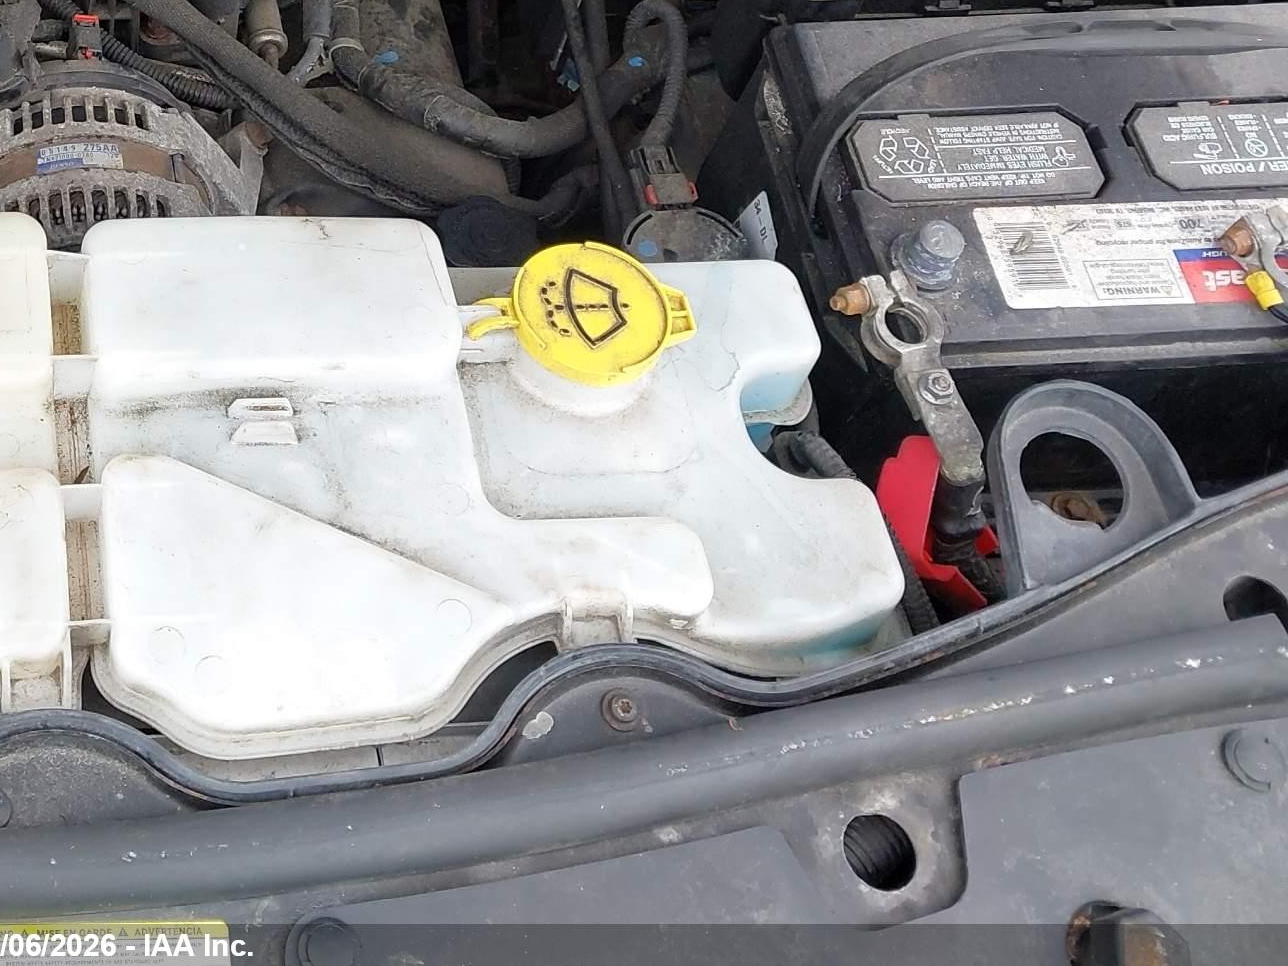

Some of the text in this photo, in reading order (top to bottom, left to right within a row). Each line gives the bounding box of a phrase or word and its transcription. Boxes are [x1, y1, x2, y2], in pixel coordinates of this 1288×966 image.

[992, 147, 1012, 155] HELP
[1011, 145, 1046, 153] MEDICAL
[1028, 153, 1049, 161] WITH
[957, 160, 1053, 171] FLUSH EYES IMMEDIATELY
[1200, 163, 1257, 176] POISON
[1179, 219, 1203, 229] 700
[1202, 249, 1230, 258] UGH
[1202, 270, 1245, 292] ast
[1102, 287, 1161, 295] WARNING:
[135, 925, 204, 938] ADVERTENCIA
